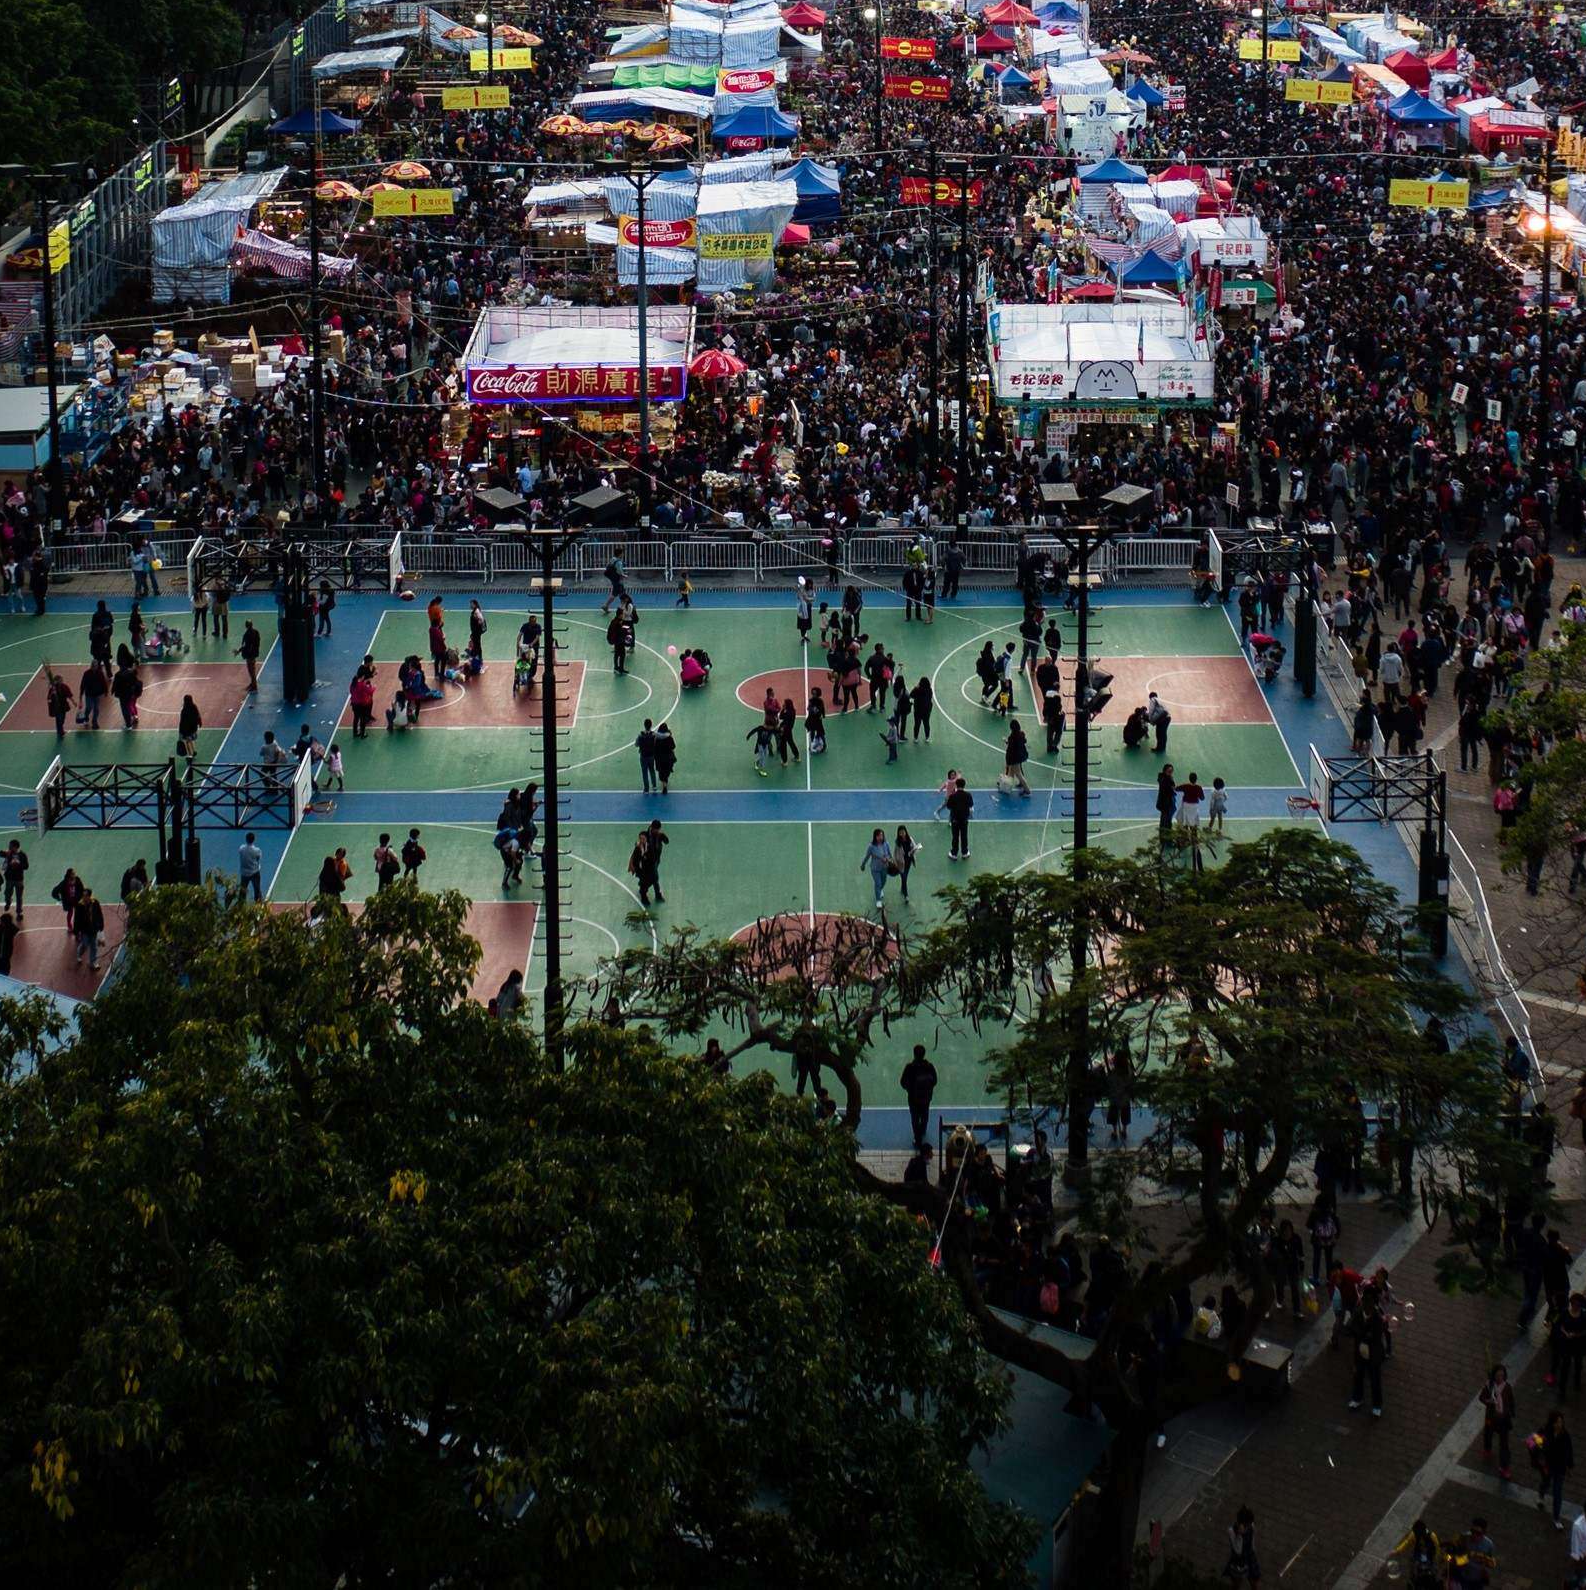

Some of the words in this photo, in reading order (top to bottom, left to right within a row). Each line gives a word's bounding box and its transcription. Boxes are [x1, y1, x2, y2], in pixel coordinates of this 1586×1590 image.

[473, 371, 541, 394] Coca-Cola
[546, 369, 657, 394] 財源廣進
